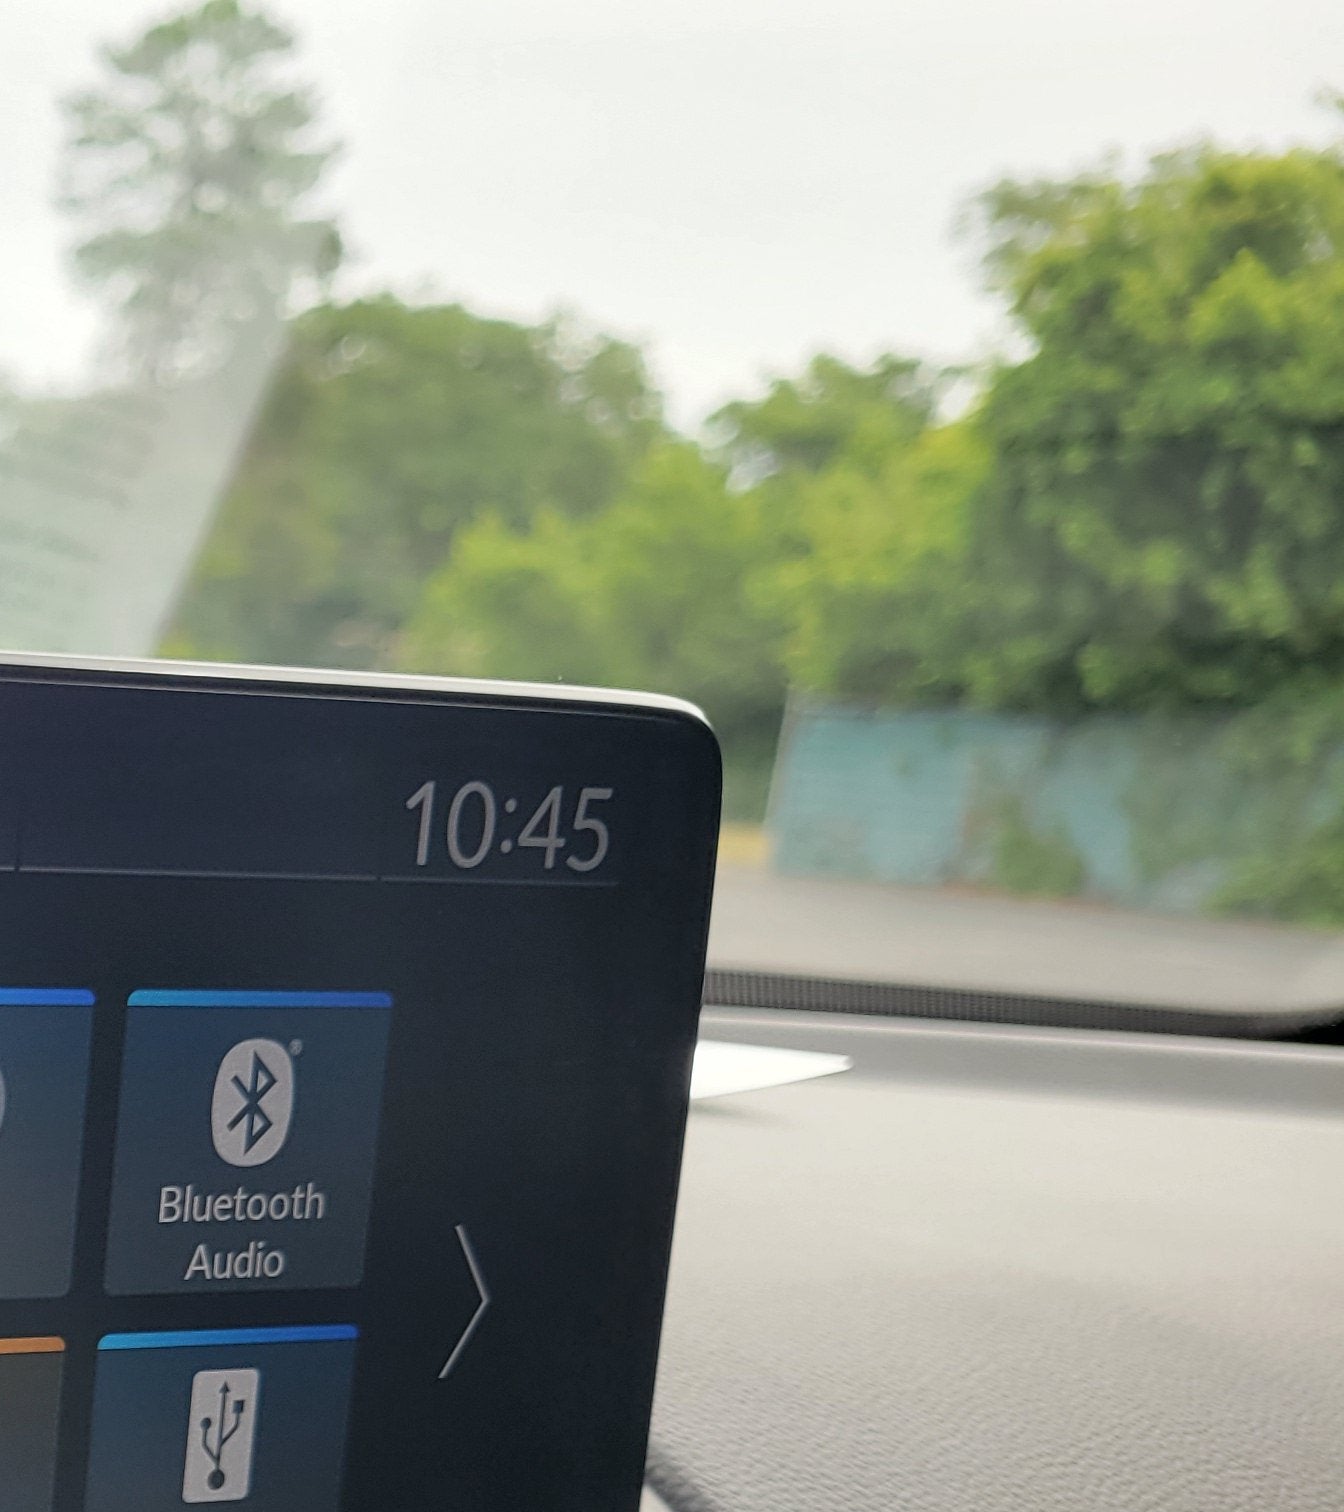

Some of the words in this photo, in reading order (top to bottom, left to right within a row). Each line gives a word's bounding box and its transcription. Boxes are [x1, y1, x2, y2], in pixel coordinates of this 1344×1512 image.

[405, 779, 614, 870] 10:45
[157, 1185, 325, 1224] Bluetooth
[185, 1244, 285, 1281] Audio
